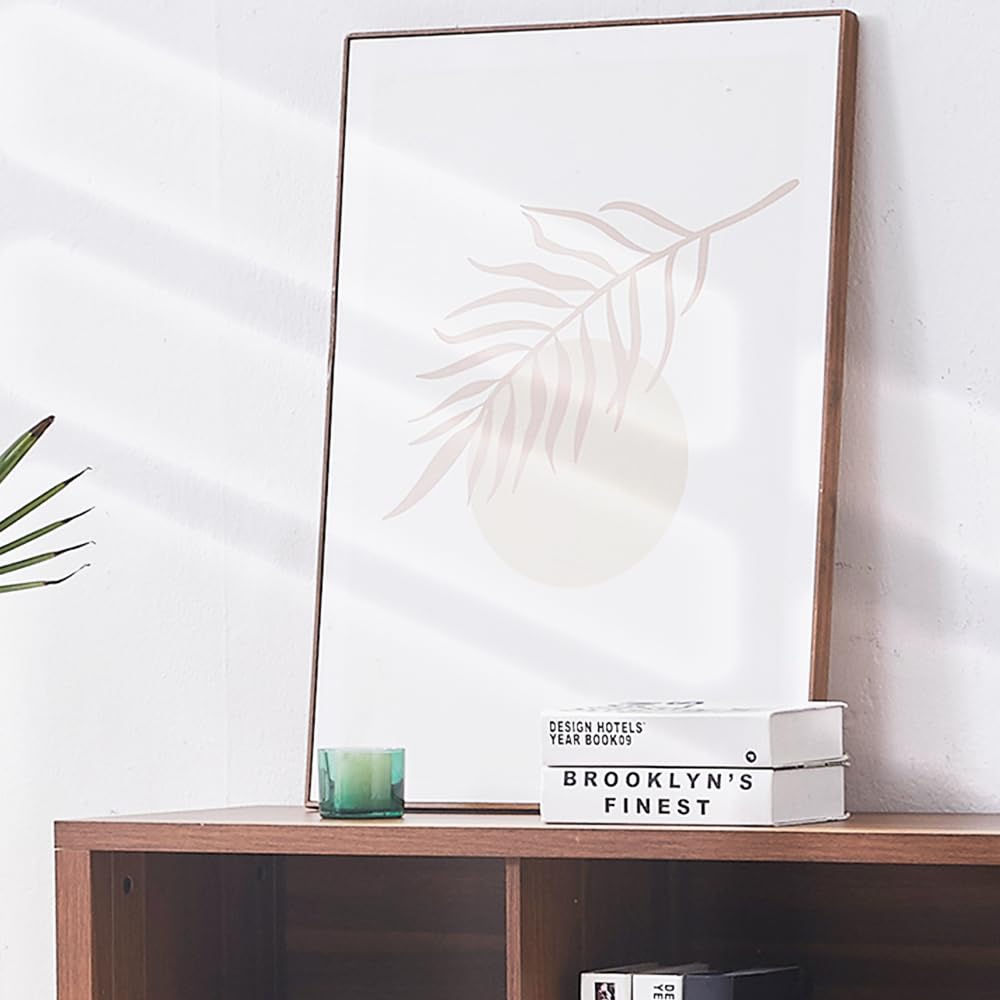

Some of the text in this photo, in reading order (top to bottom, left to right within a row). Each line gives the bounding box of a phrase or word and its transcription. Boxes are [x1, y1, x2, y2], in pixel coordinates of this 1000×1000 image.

[549, 721, 643, 734] DESIGN HOTELS
[549, 733, 580, 745] YEAR
[563, 771, 753, 790] BROOKLYN’S
[605, 798, 710, 815] FINEST
